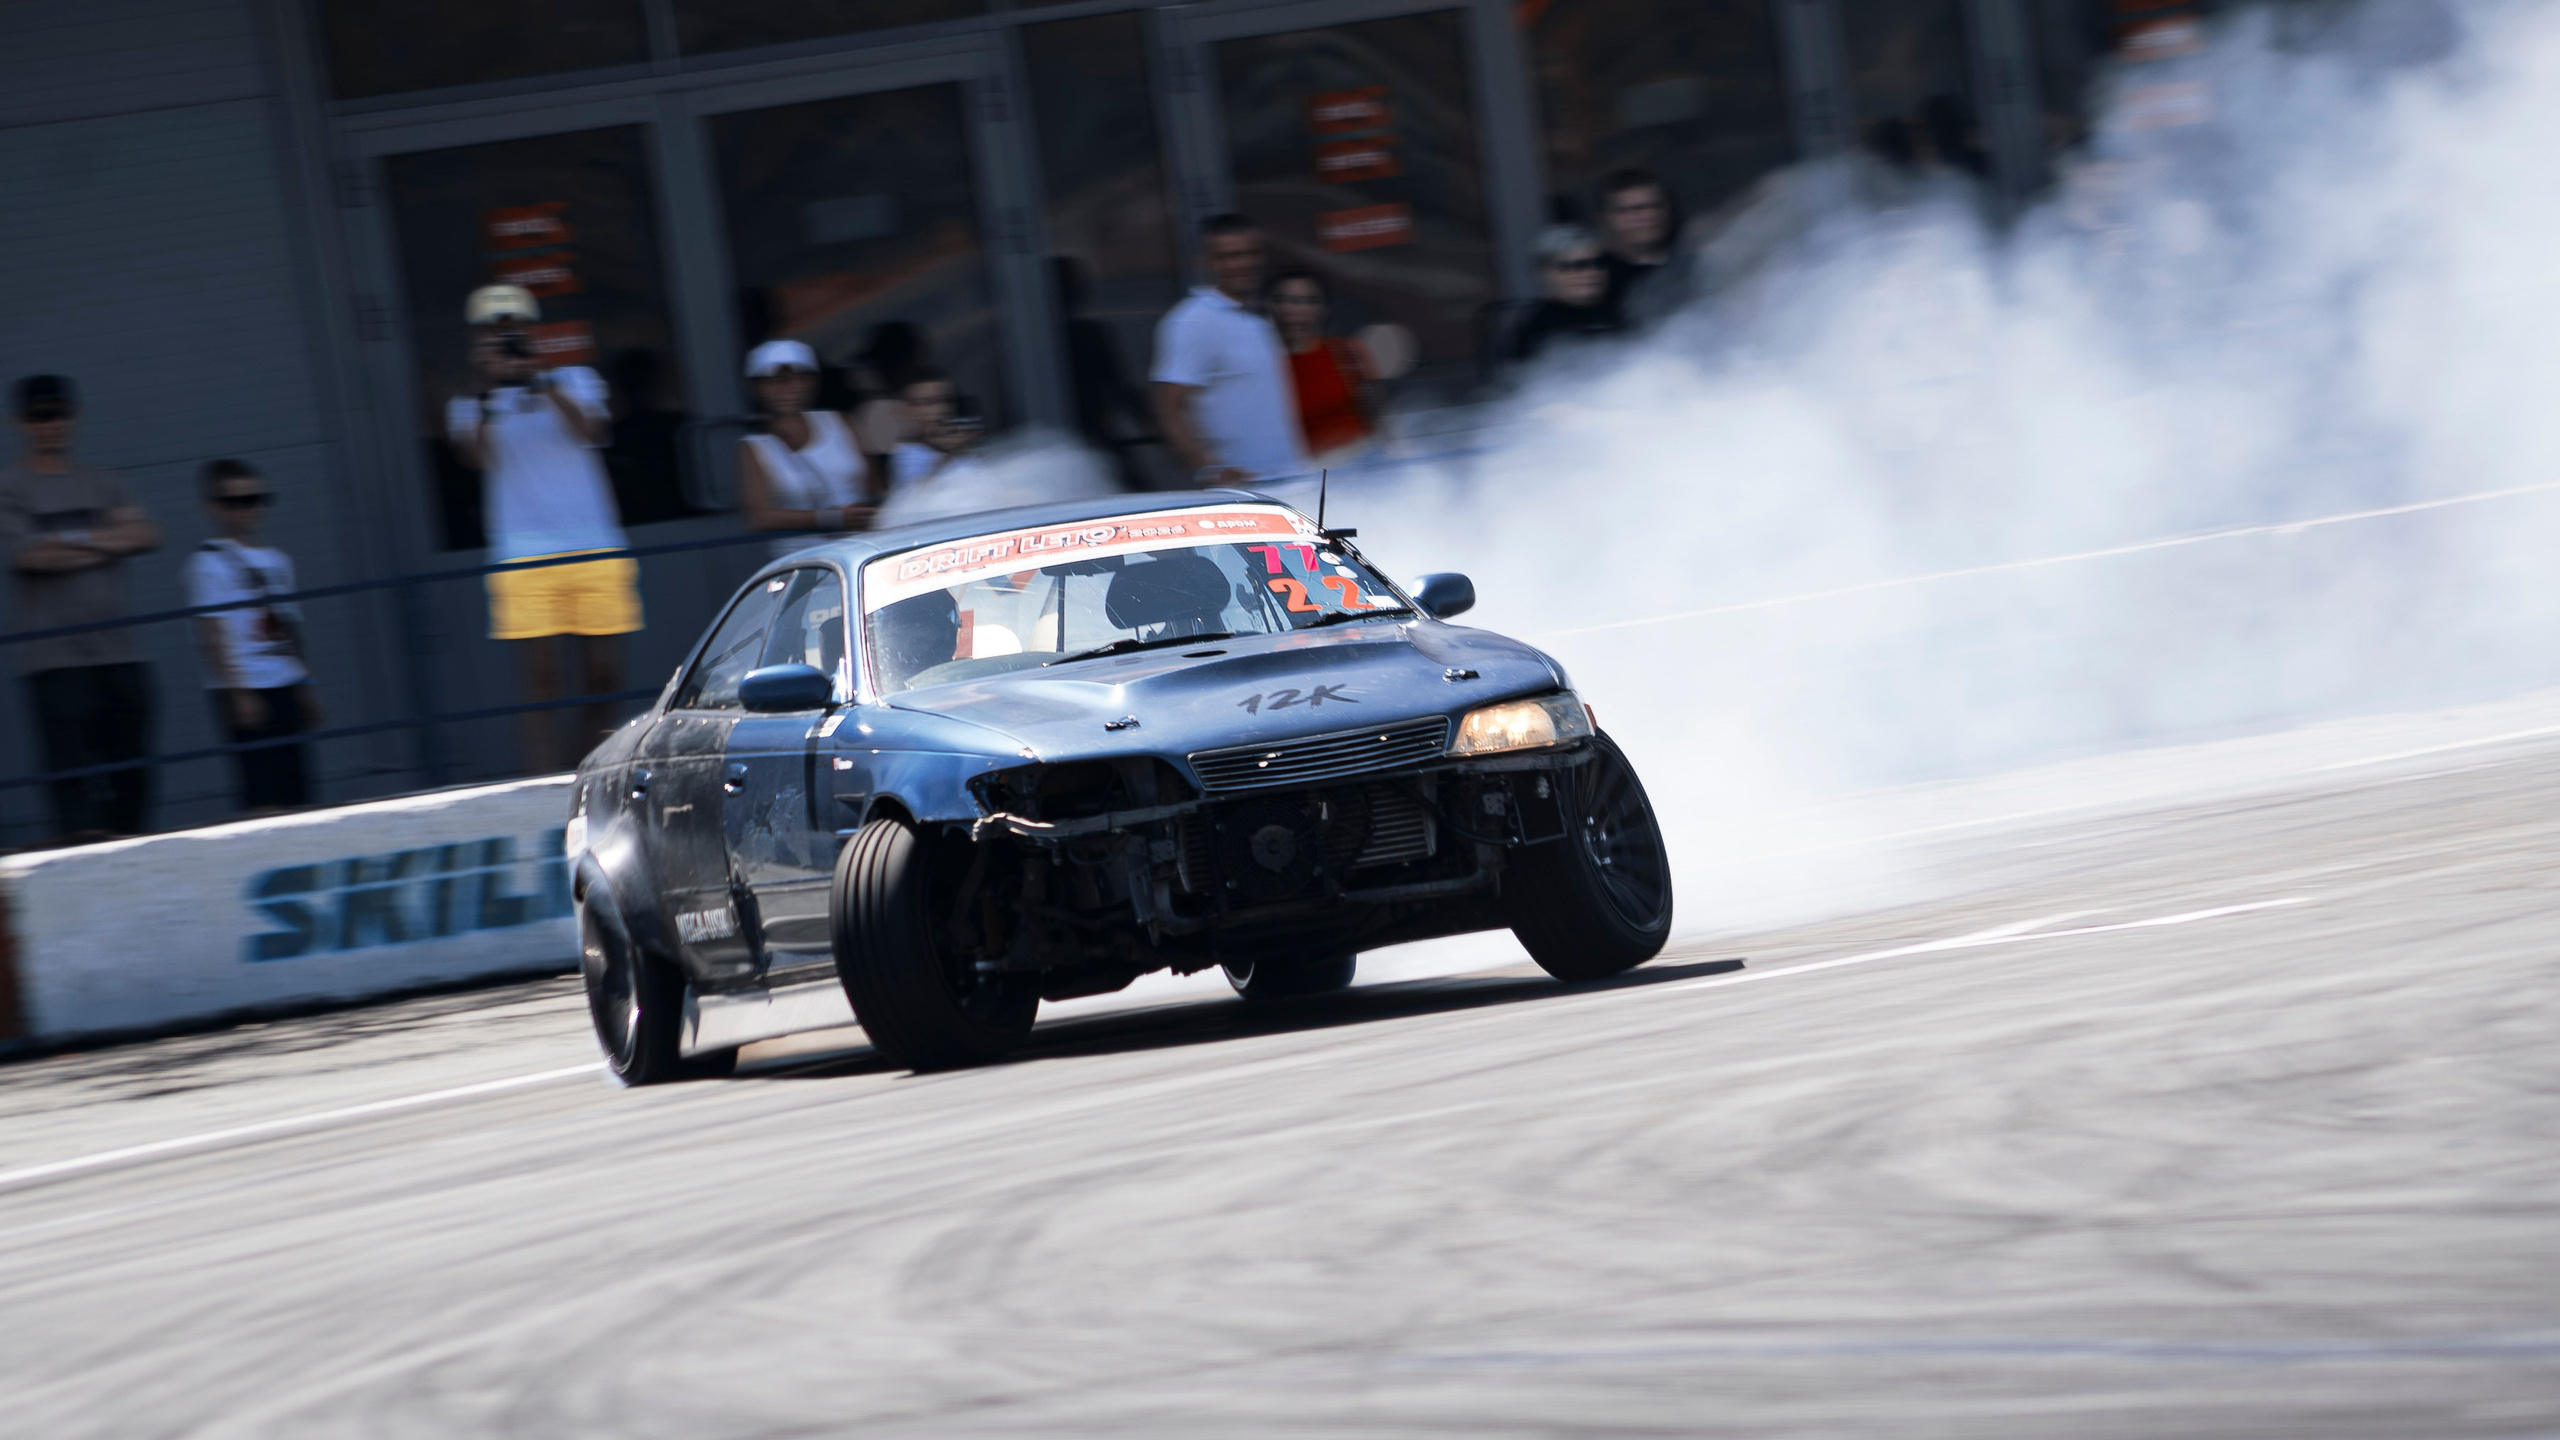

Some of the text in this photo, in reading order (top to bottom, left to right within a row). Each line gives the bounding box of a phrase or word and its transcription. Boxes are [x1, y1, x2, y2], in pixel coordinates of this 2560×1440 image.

[898, 538, 1015, 580] DRIFT
[1020, 525, 1117, 553] LETO
[1247, 544, 1320, 574] 77
[1267, 576, 1376, 613] 22
[1237, 683, 1362, 716] 12K
